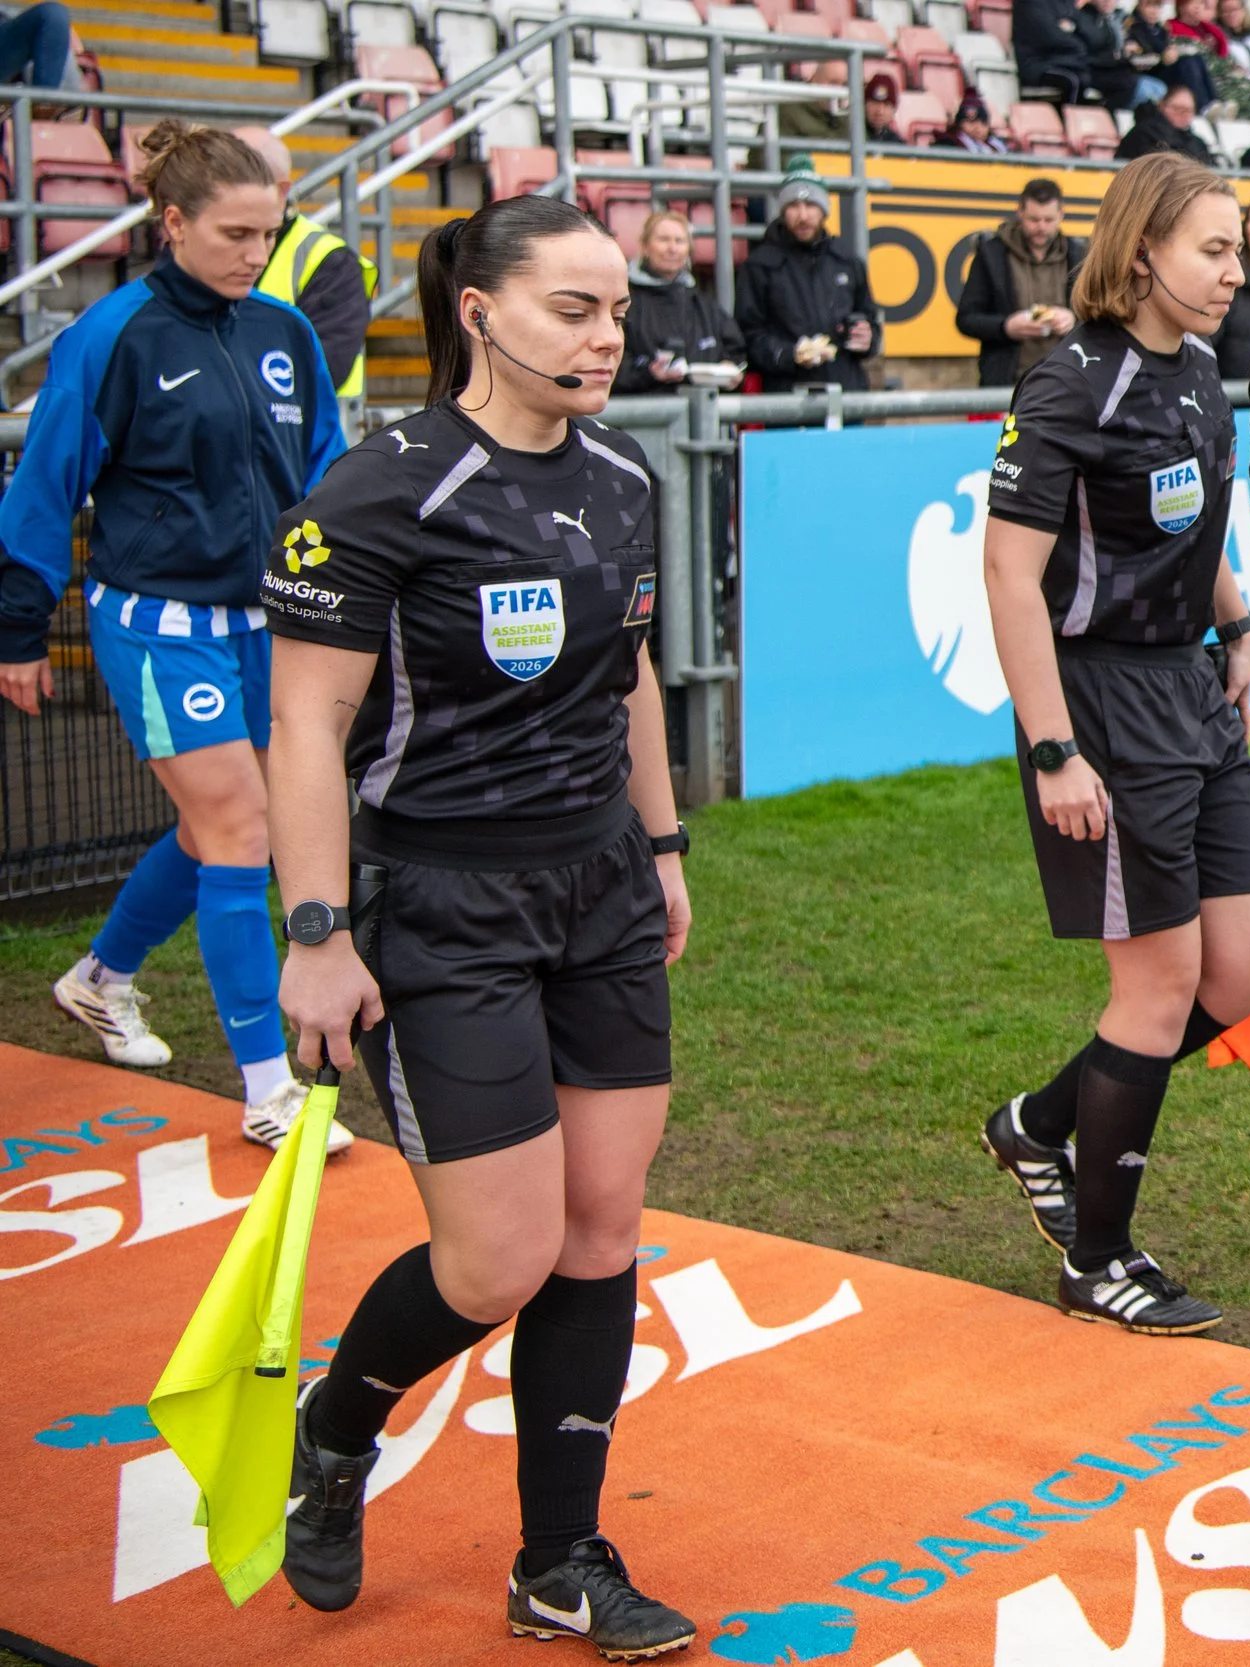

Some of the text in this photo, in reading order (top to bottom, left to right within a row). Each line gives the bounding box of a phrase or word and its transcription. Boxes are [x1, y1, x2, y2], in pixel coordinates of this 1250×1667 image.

[991, 477, 1018, 492] upplies
[1156, 466, 1198, 492] FIFA
[1168, 519, 1189, 529] 2026
[262, 569, 345, 609] HuwsGray
[490, 587, 556, 615] FIFA
[286, 603, 343, 623] Supplies
[491, 622, 557, 637] ASSISTANT
[496, 634, 553, 648] REFEREE
[509, 660, 542, 672] 2026
